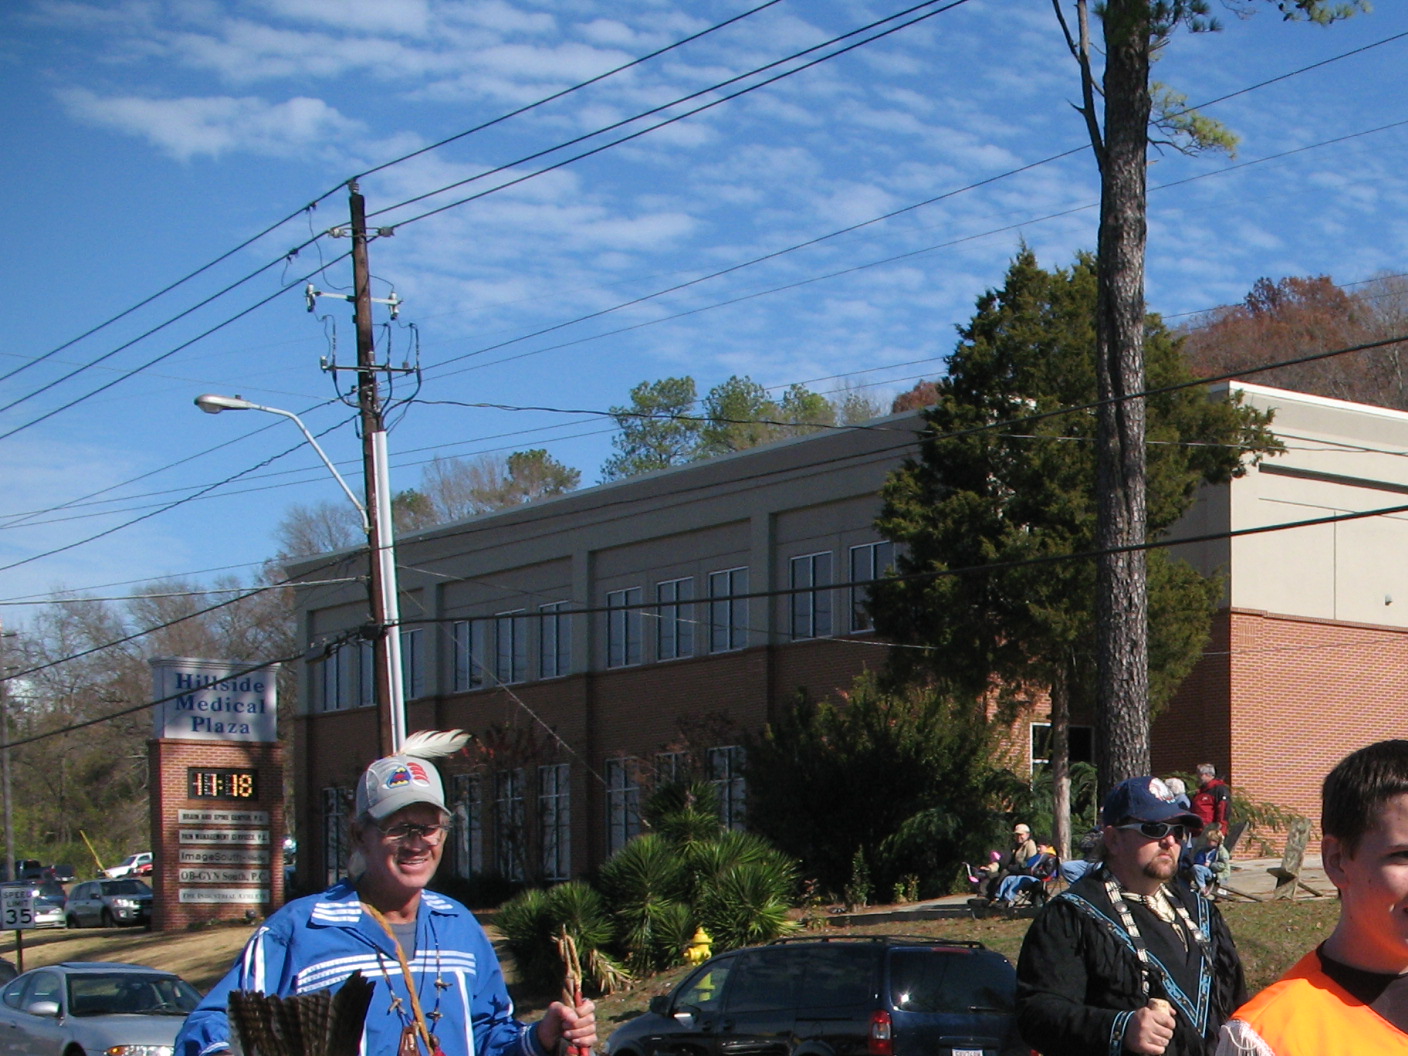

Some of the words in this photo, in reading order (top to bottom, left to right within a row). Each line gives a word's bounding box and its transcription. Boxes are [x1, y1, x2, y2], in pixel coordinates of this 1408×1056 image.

[175, 672, 265, 693] Hillside
[175, 695, 267, 714] Medical
[191, 715, 251, 734] Plaza
[193, 772, 253, 797] 11:18
[181, 871, 220, 881] OB-GYN
[3, 891, 32, 899] SPEED
[6, 909, 32, 924] 35
